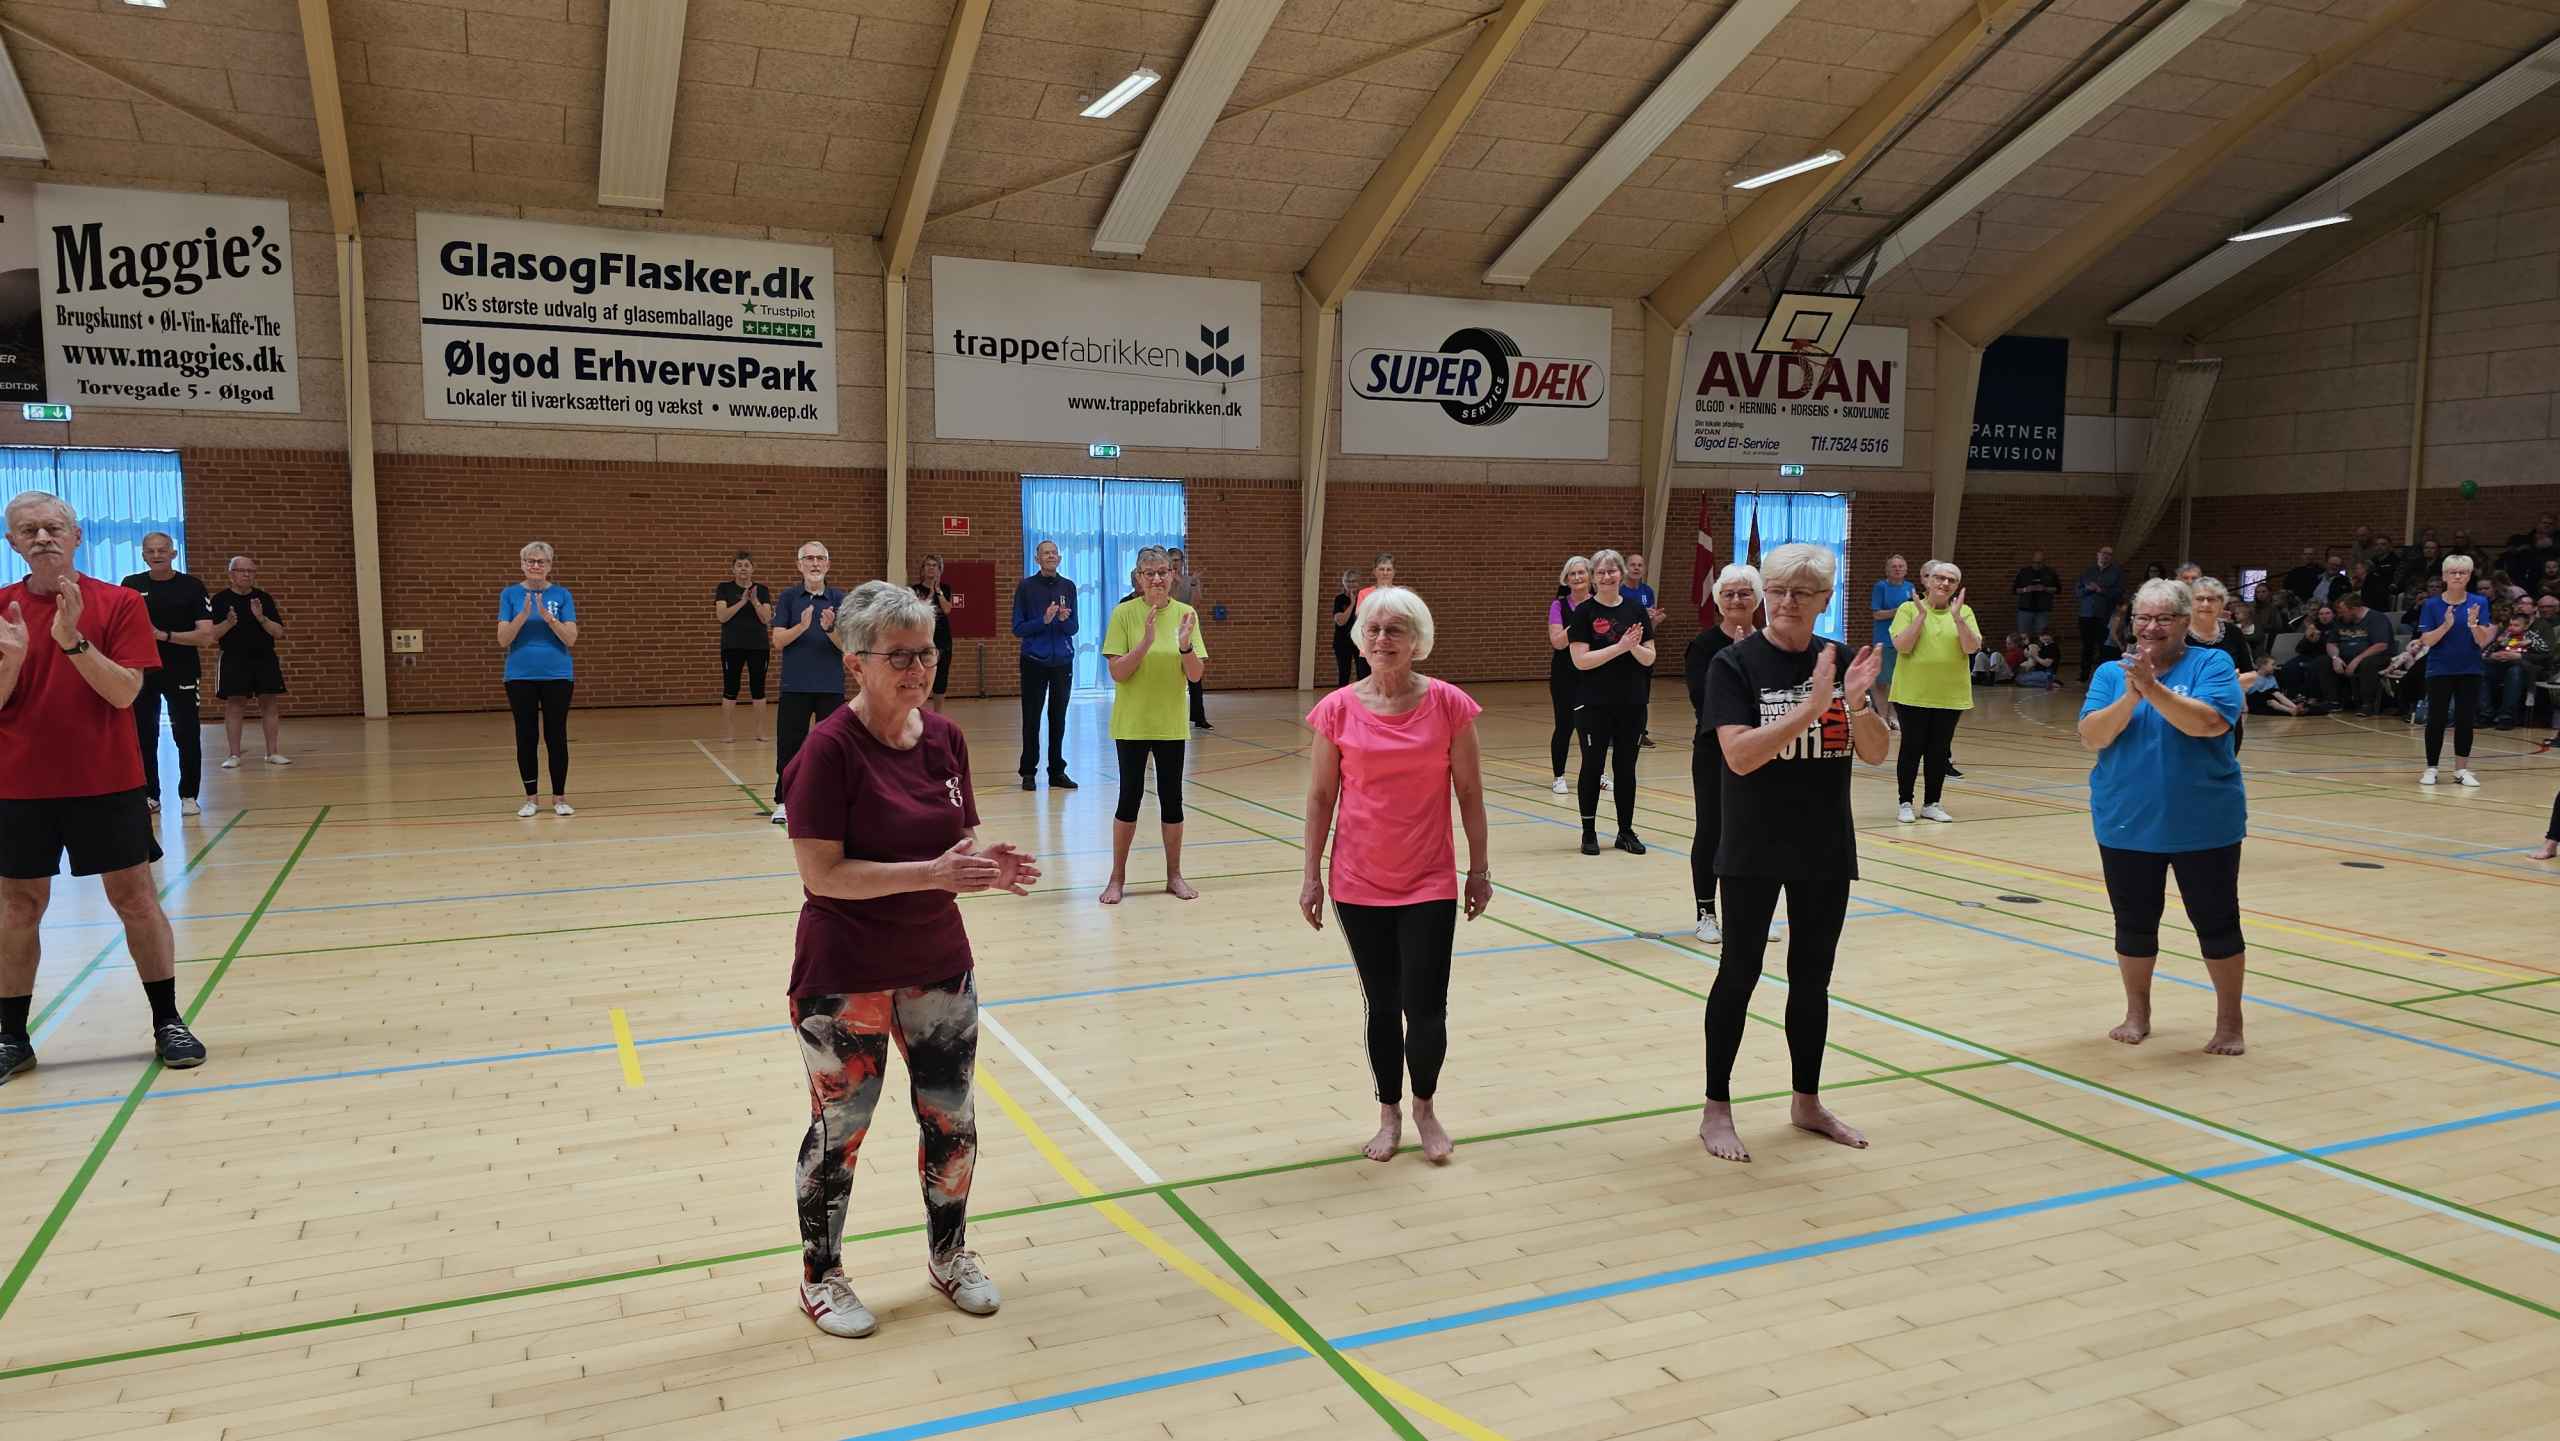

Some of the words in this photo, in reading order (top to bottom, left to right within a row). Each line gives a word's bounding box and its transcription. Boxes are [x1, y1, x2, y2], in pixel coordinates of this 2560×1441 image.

[52, 222, 282, 298] Maggie's
[439, 240, 815, 301] GlasogFlasker.dk
[56, 304, 143, 334] Brugskunst
[160, 308, 281, 337] Øl-Vin-Kaffe-The
[442, 291, 477, 313] DK's
[482, 297, 538, 316] største
[544, 299, 597, 324] udvalg
[603, 303, 619, 320] af
[624, 305, 733, 331] glasemballage
[760, 303, 816, 320] Trustpilot
[62, 342, 287, 378] www.maggies.dk
[953, 329, 1180, 368] trappefabrikken
[444, 340, 559, 385] Ølgod
[574, 347, 817, 393] ErhvervsPark
[1366, 353, 1482, 397] SUPER
[1512, 361, 1592, 401] DÆK
[1696, 351, 1892, 404] AVDAN
[77, 379, 180, 401] Torvegade
[187, 384, 198, 399] 5
[219, 384, 275, 405] Ølgod
[446, 387, 507, 407] Lokaler
[512, 390, 527, 408] til
[531, 391, 631, 412] iværksætteri
[635, 398, 653, 416] og
[658, 398, 704, 416] vækst
[729, 401, 818, 421] www.øep.dk
[1068, 395, 1243, 417] www.trappefabrikken.dk
[1461, 375, 1505, 418] SERVICE
[1695, 400, 1725, 413] ØLGOD
[1739, 401, 1777, 415] HERNING
[1791, 403, 1830, 417] HORSENS
[1842, 407, 1890, 420] SKOVLUNDE
[1695, 436, 1726, 451] Ølgod
[1860, 438, 1889, 453] 5516
[1971, 423, 2057, 440] PARTNER
[1969, 446, 2056, 460] REVISION
